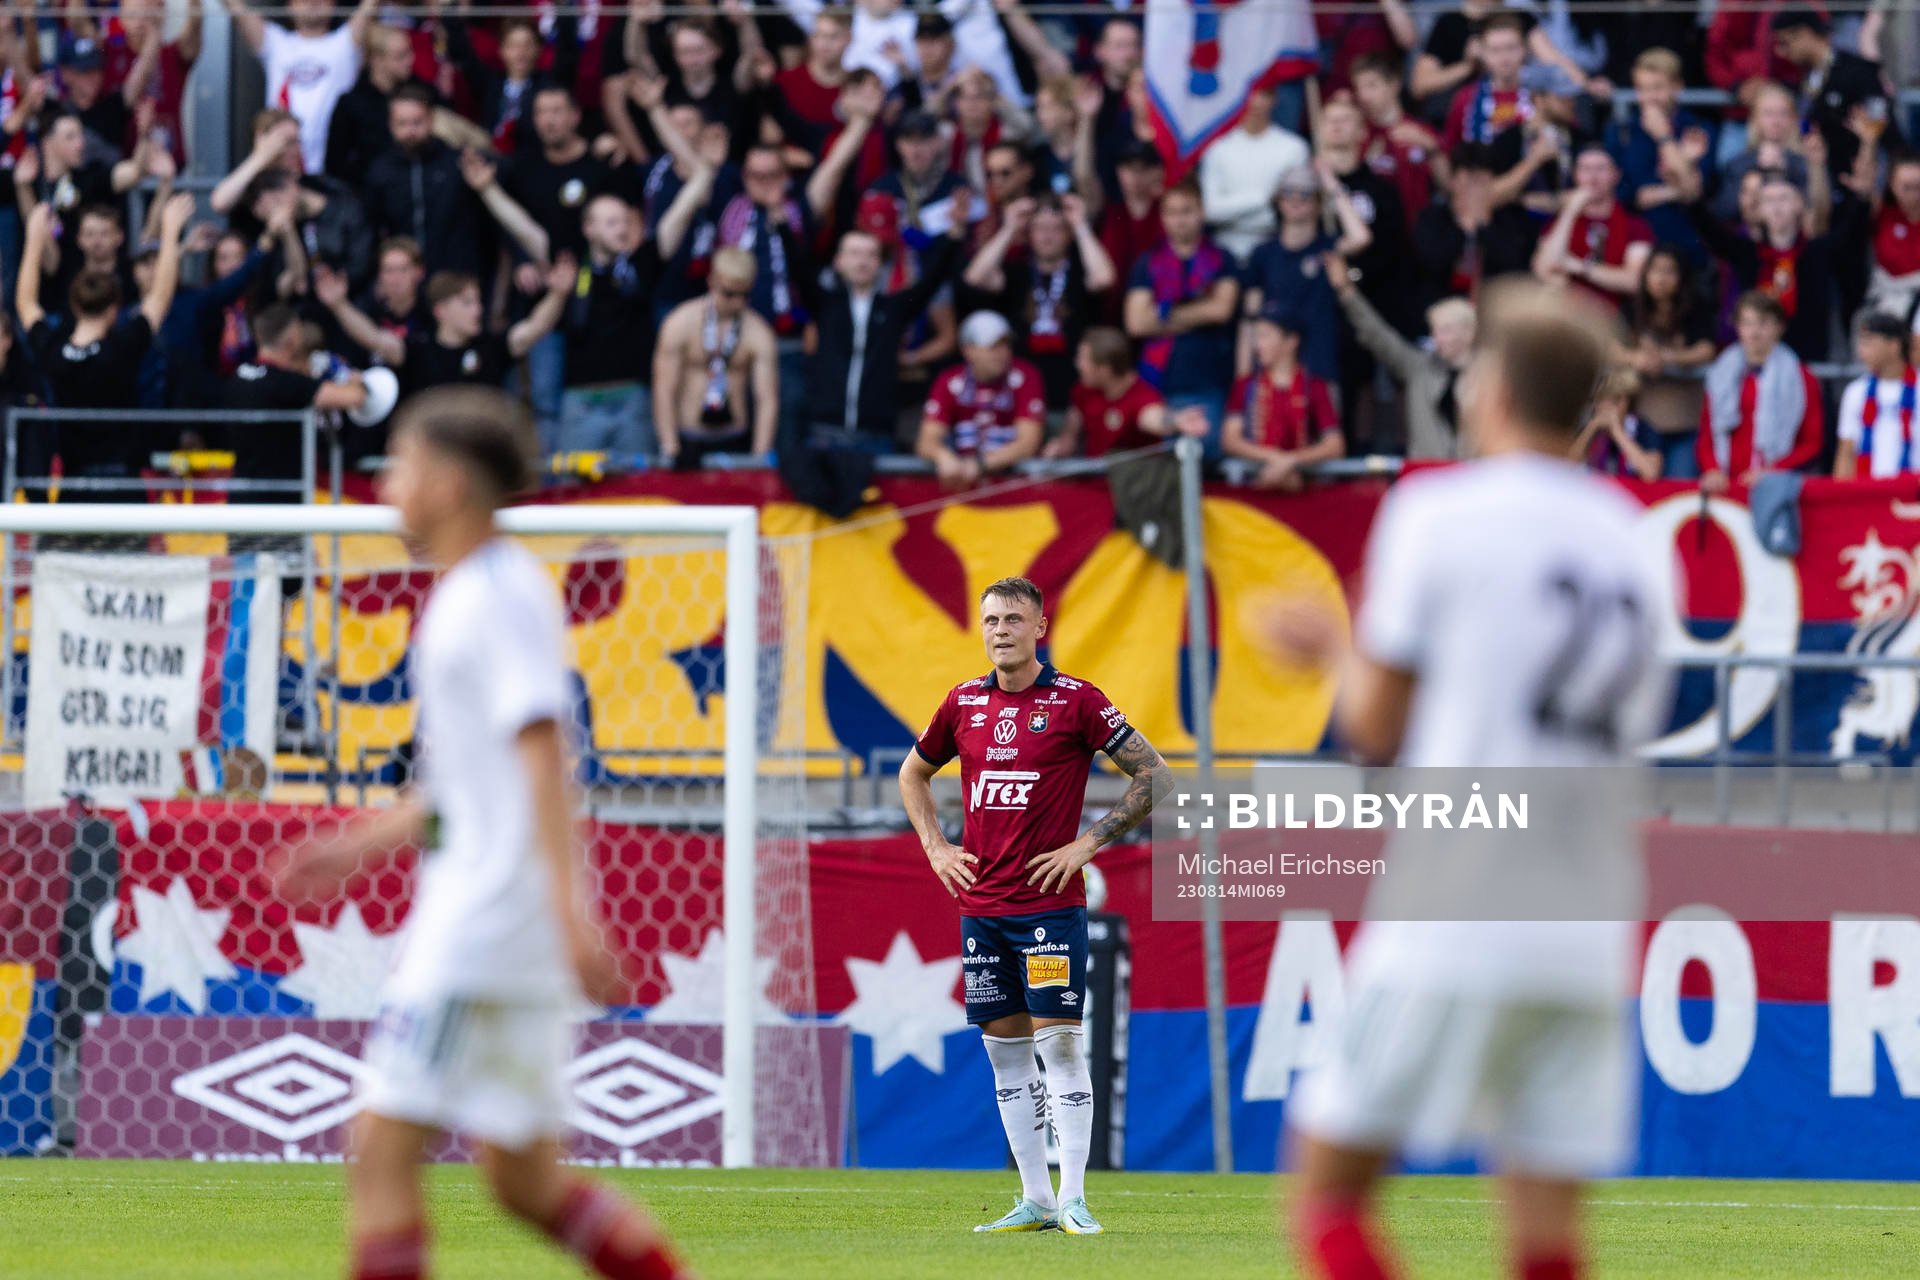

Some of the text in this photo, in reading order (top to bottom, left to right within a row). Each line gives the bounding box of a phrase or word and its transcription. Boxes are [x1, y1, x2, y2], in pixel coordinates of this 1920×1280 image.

[86, 586, 165, 624] SKAM
[61, 632, 184, 677] DEN SOM
[61, 690, 108, 725] GER
[1100, 705, 1118, 719] Nor
[987, 747, 1018, 756] factoring
[1105, 738, 1117, 749] FREE
[65, 746, 161, 785] KRIGA!
[970, 770, 1040, 812] NTEX
[1028, 960, 1066, 970] TRIUMF
[997, 1095, 1021, 1103] mbro
